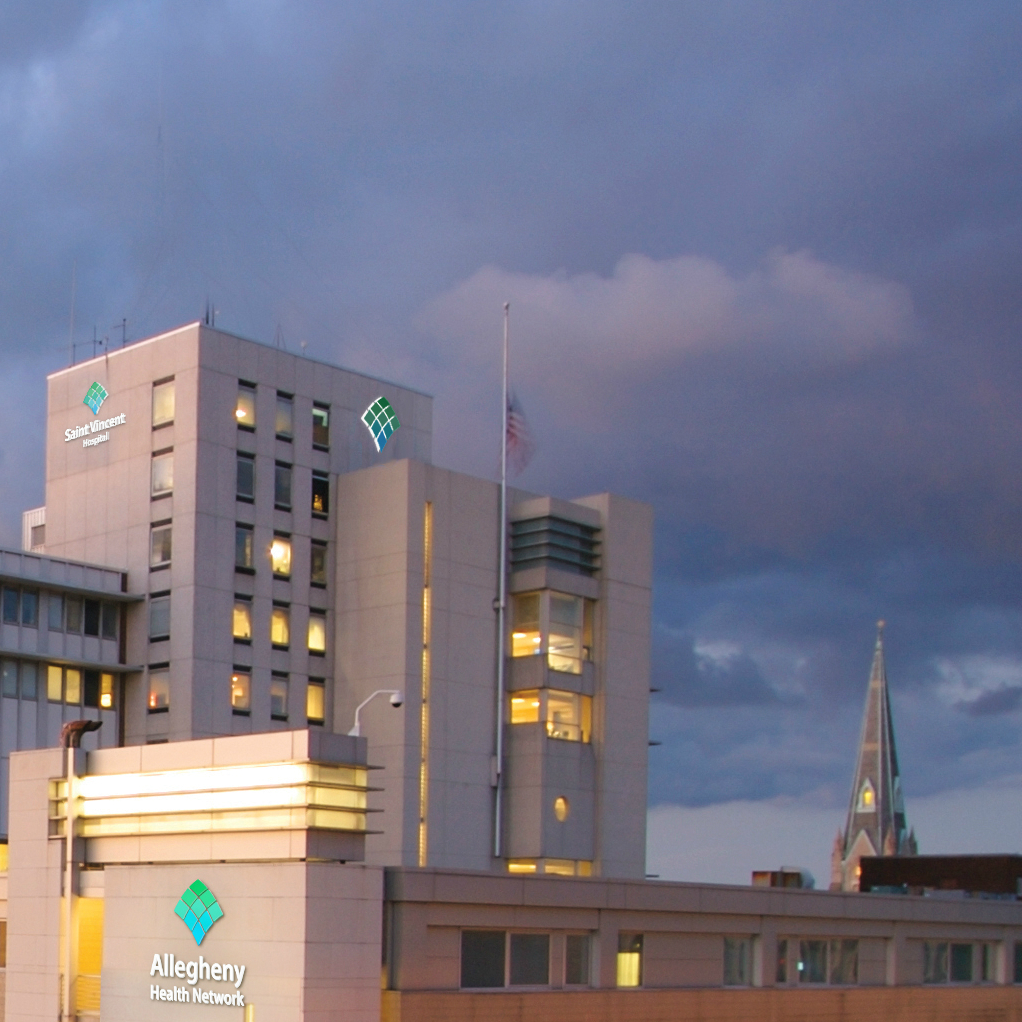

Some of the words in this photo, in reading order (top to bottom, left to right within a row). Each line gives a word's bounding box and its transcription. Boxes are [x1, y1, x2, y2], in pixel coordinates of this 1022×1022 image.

[65, 424, 90, 441] Saint
[90, 413, 125, 432] Vincent
[83, 432, 109, 447] Hospital
[150, 953, 246, 989] Allegheny
[150, 984, 190, 1003] Health
[192, 987, 245, 1007] Network
